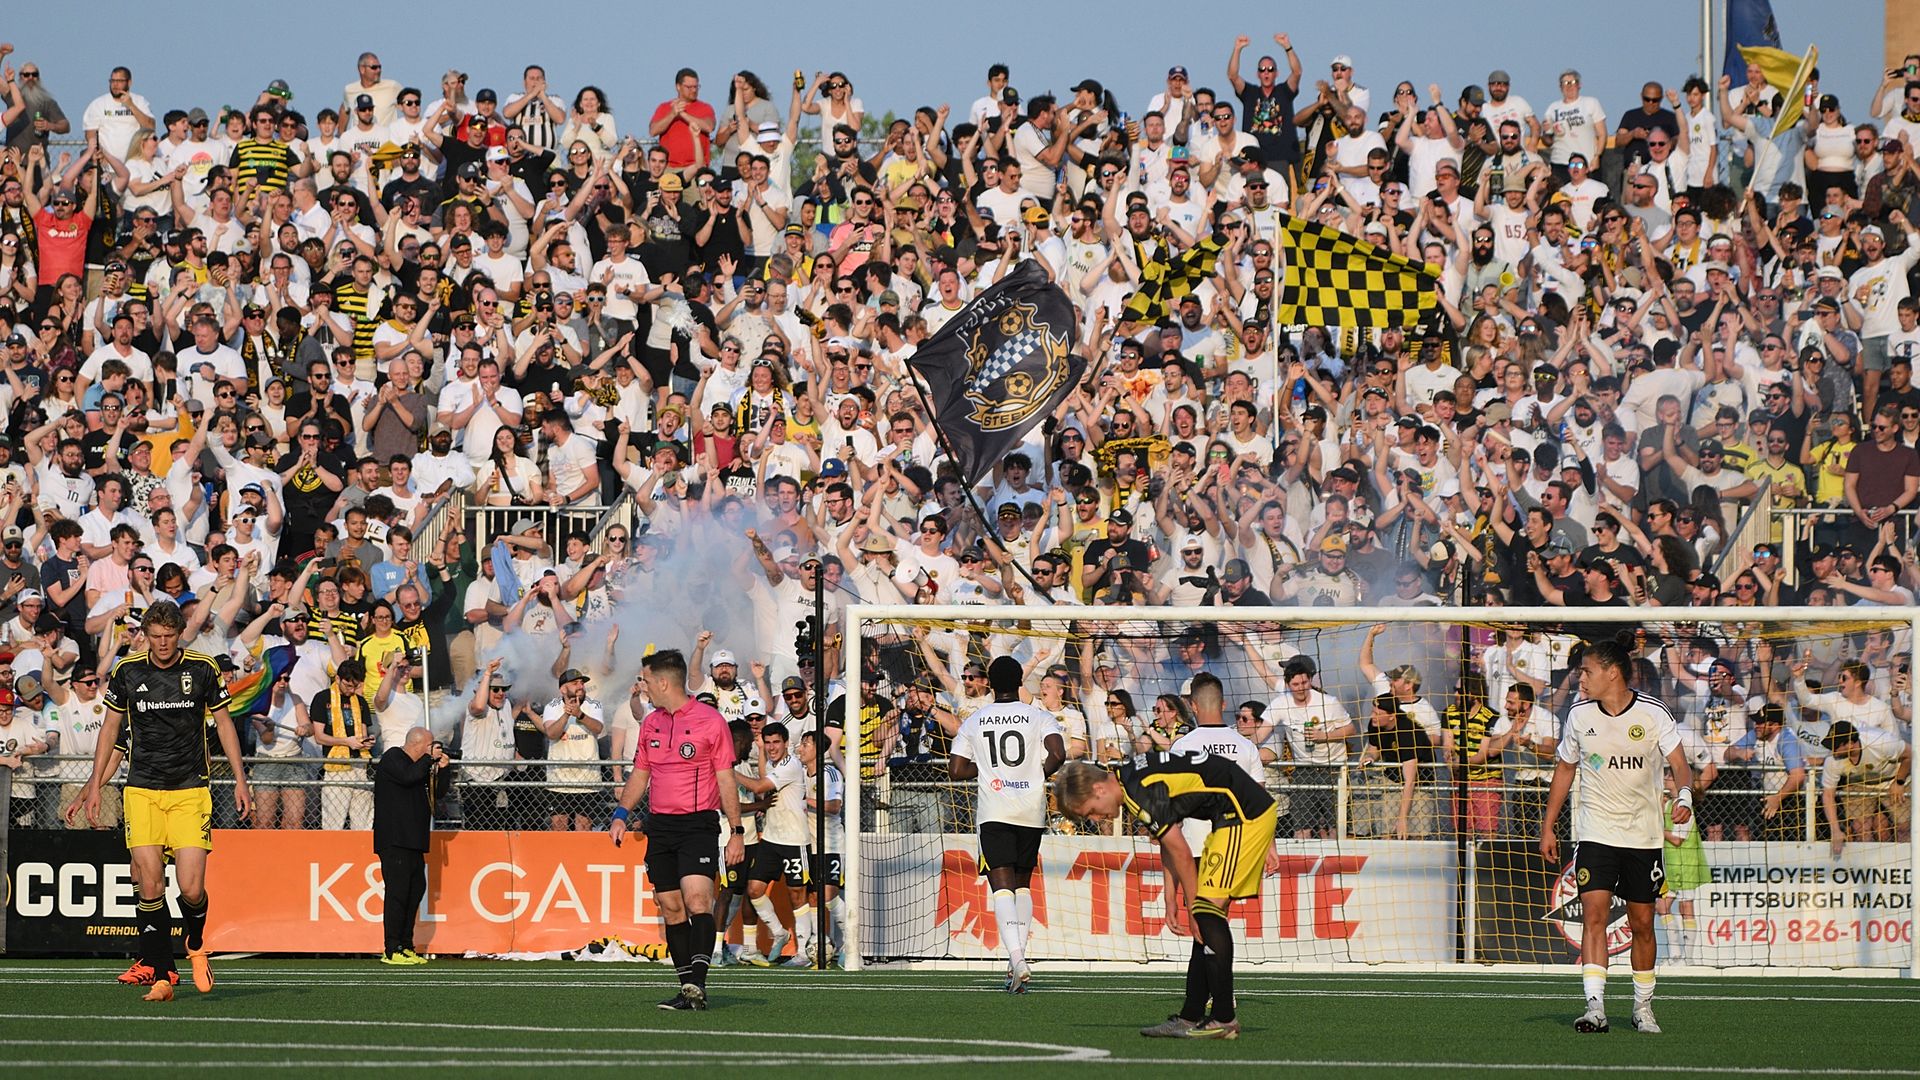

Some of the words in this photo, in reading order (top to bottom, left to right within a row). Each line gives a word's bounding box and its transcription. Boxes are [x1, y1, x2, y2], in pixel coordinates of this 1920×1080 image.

[1073, 260, 1089, 274] AHN
[1318, 589, 1341, 599] AHN
[147, 700, 195, 710] Nationwide
[724, 706, 743, 716] AHN
[84, 722, 102, 732] AHN
[979, 715, 1029, 726] HARMON
[983, 730, 1025, 768] 10
[1202, 744, 1237, 754] MERTZ
[1607, 756, 1644, 770] AHN
[1001, 779, 1029, 789] LUMBER
[783, 858, 802, 874] 23
[1650, 860, 1664, 882] 6
[1710, 867, 1825, 884] EMPLOYEE
[1710, 891, 1843, 909] PITTSBURGH
[1707, 918, 1777, 945] (412)
